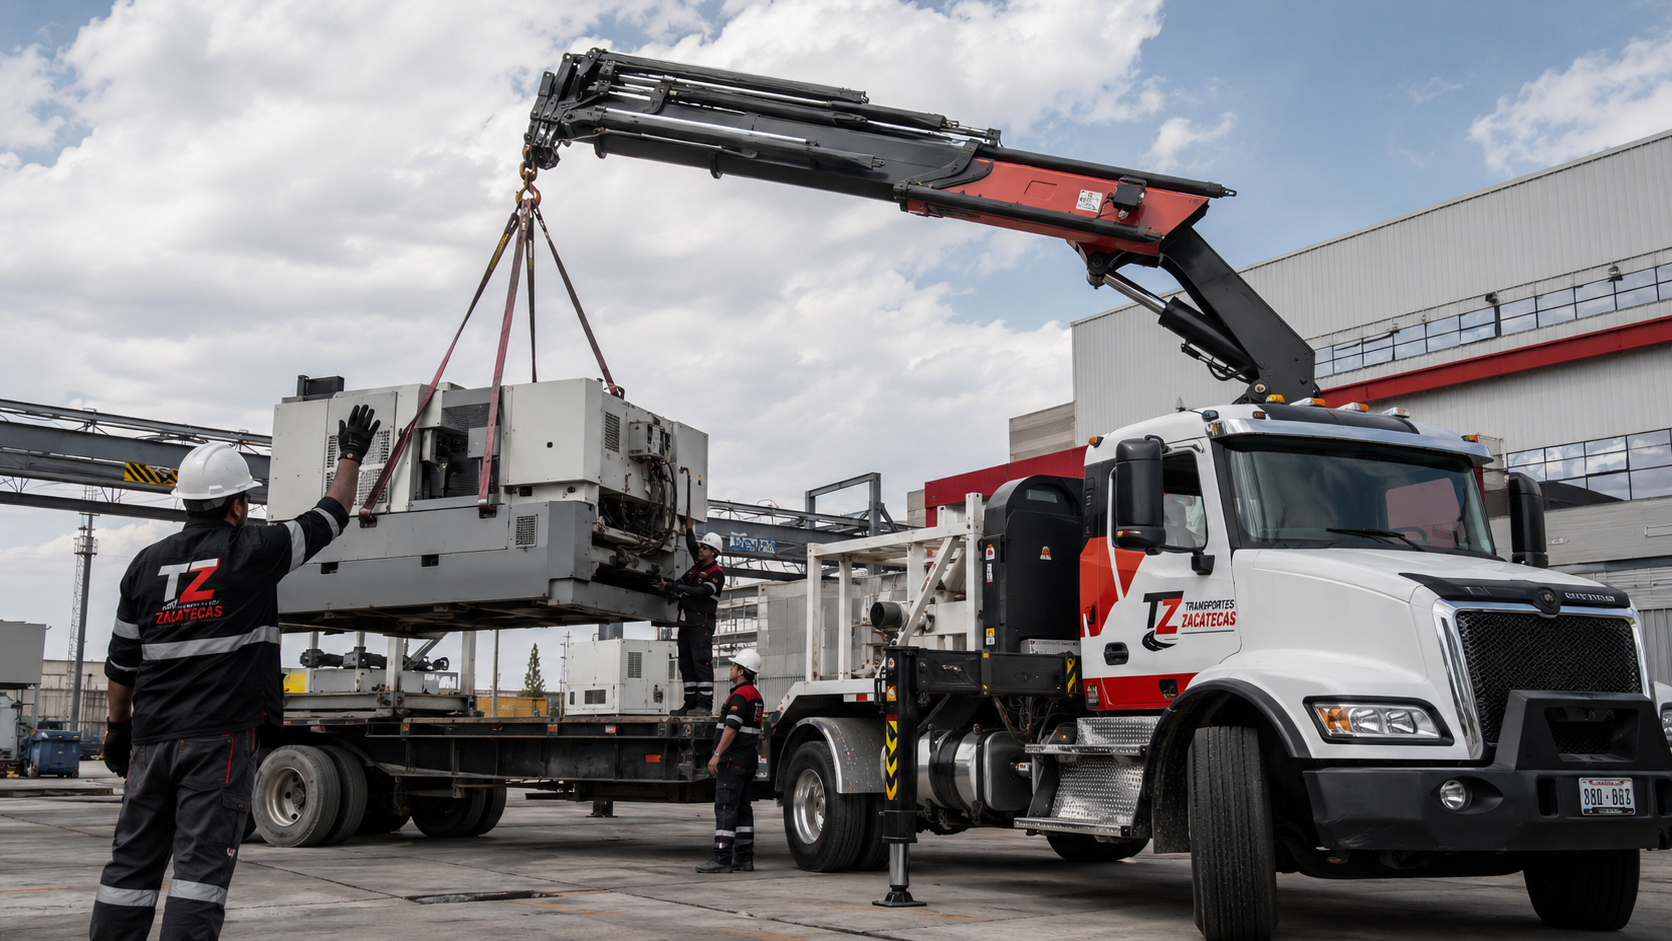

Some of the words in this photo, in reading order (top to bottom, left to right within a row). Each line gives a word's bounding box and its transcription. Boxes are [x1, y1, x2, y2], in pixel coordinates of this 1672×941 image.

[157, 558, 221, 603] TZ
[1142, 590, 1184, 635] TZ
[1181, 611, 1237, 628] ZACATECAS
